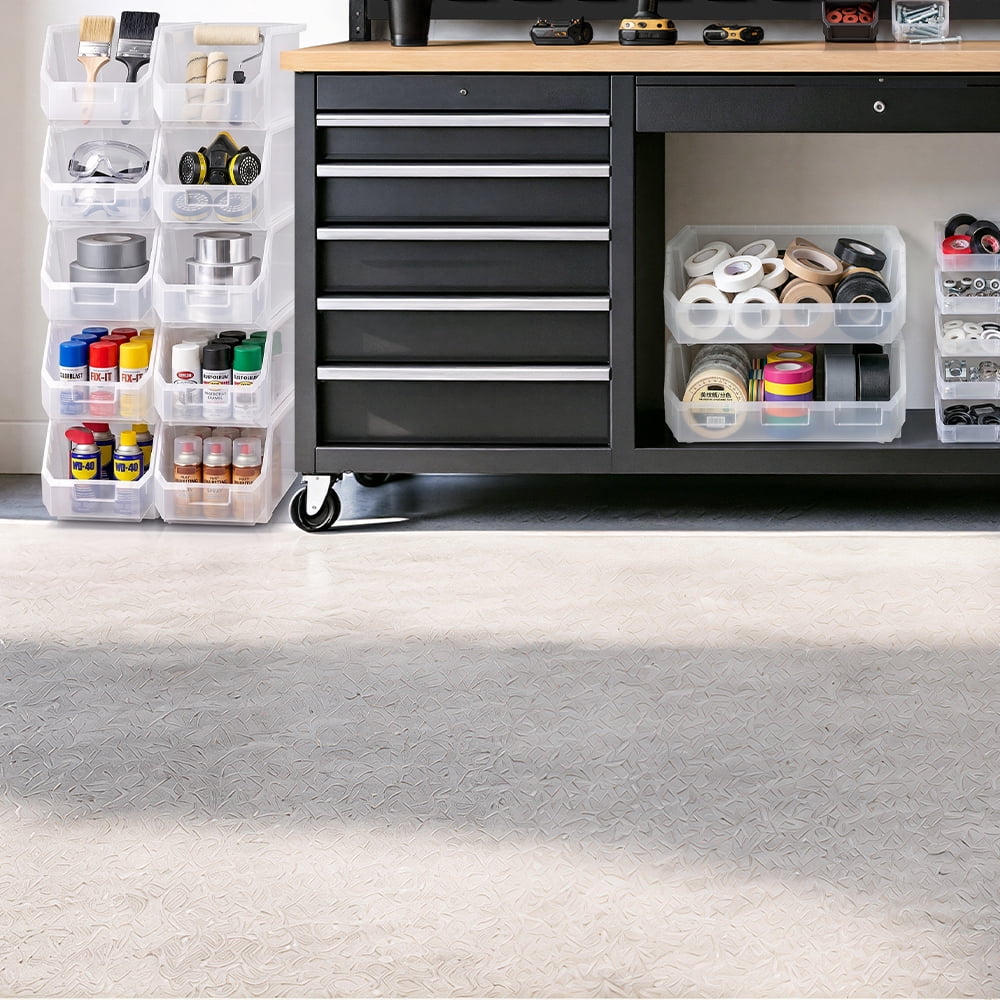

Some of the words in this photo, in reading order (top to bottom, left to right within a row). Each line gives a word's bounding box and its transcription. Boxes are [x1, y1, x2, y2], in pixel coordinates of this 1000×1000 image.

[90, 372, 112, 382] FIX-IT
[73, 461, 95, 471] WD-40
[115, 462, 139, 472] WD-40
